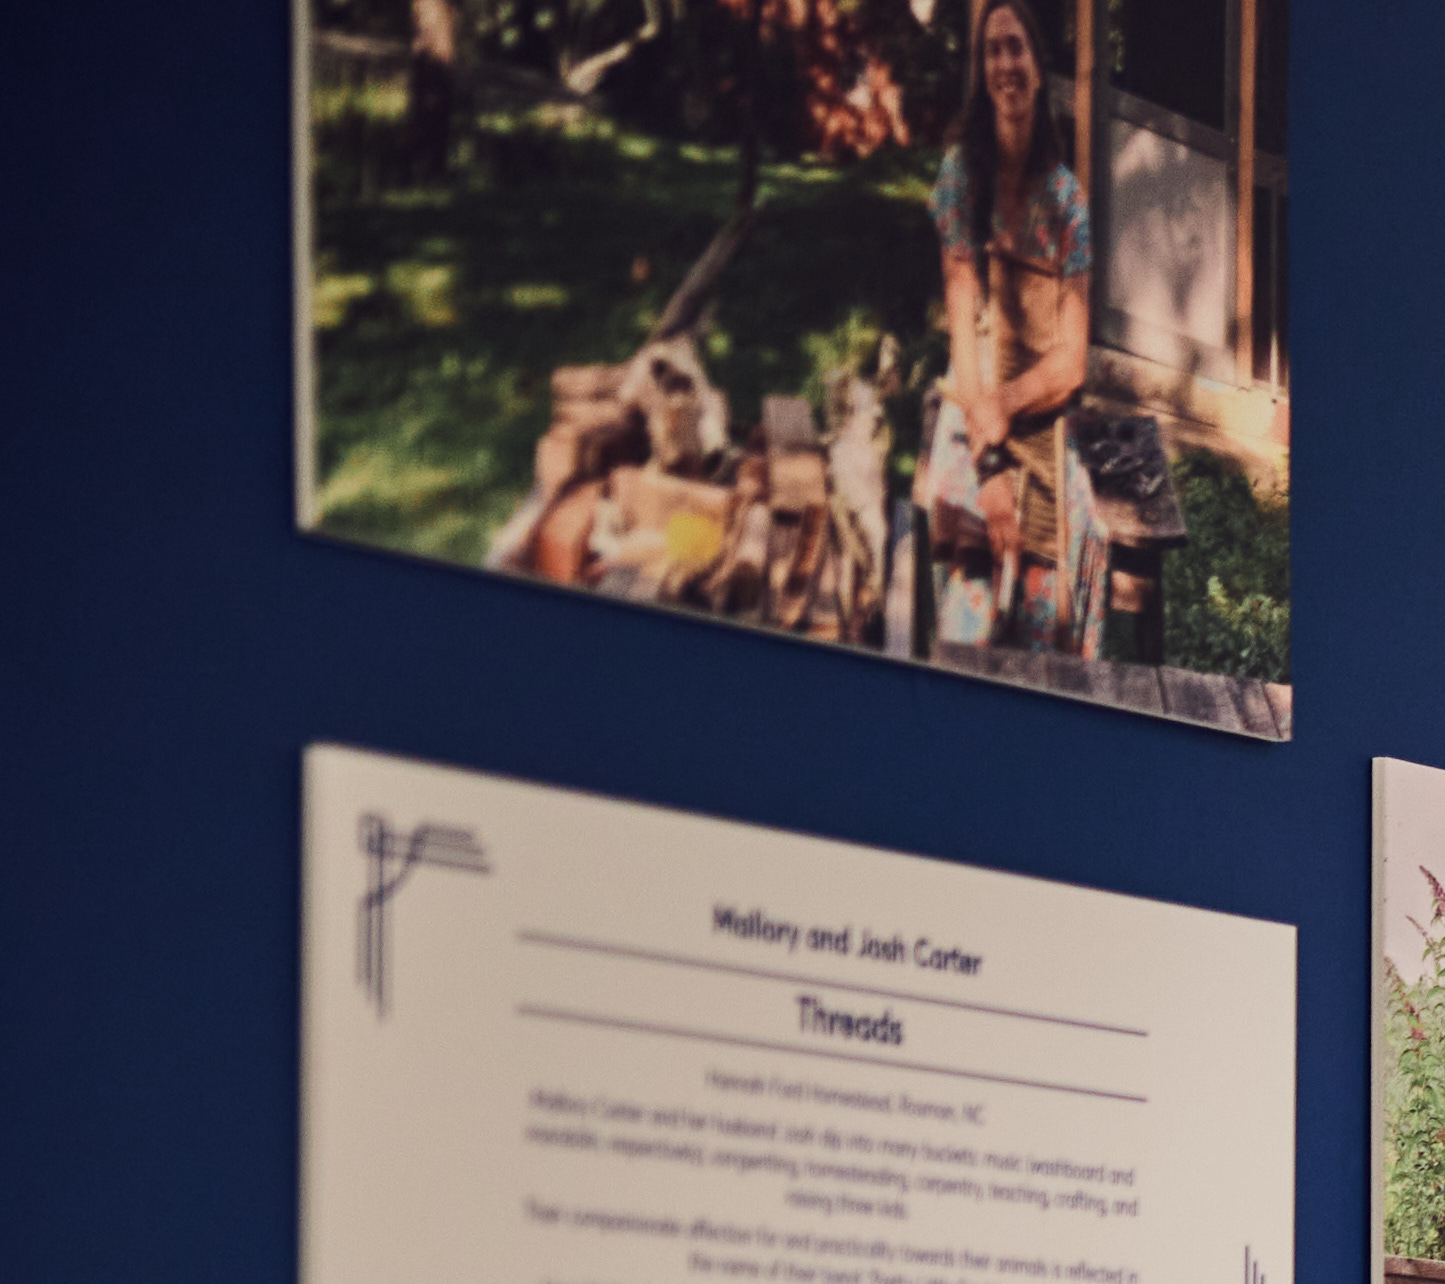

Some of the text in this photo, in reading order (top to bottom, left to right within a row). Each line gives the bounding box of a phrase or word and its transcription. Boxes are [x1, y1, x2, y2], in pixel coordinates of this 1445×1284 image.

[713, 906, 982, 974] Mallory and Josh Carter
[797, 995, 904, 1044] Threads
